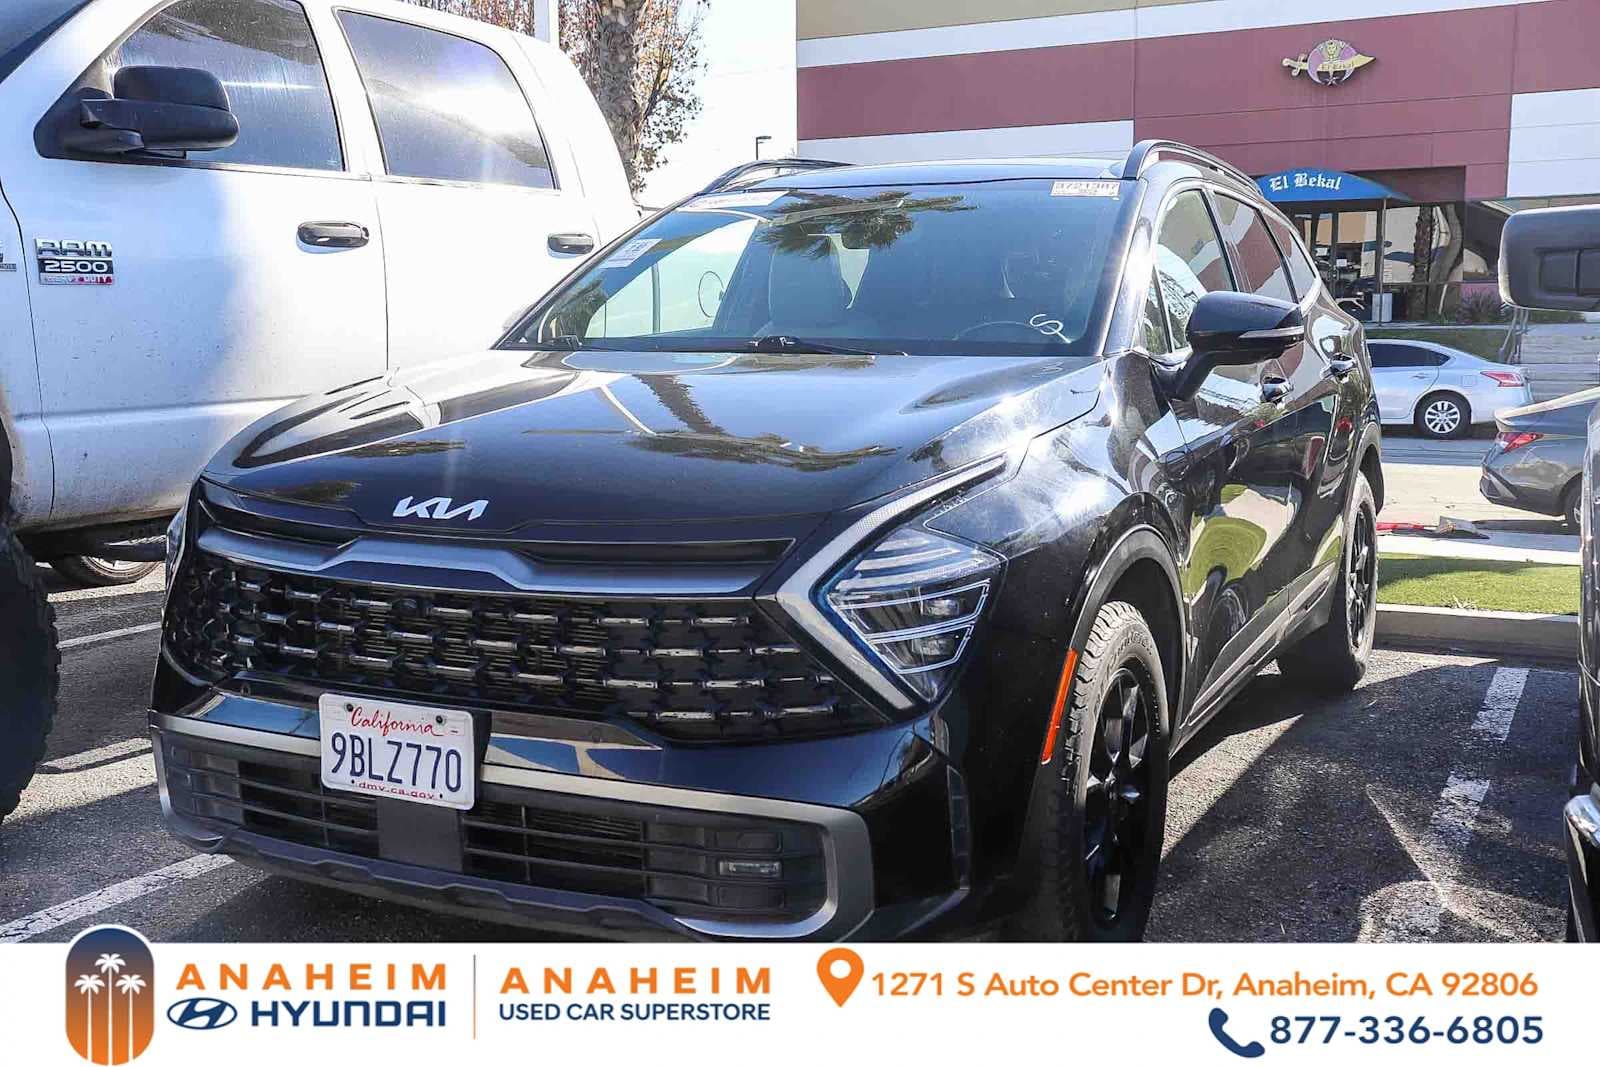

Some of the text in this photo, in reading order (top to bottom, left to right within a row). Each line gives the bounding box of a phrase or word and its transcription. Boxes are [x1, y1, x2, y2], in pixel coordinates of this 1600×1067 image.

[1270, 172, 1342, 192] El Bekal
[35, 238, 113, 257] RAM
[44, 260, 108, 272] 2500
[392, 495, 489, 521] KIA
[351, 706, 444, 737] California
[331, 731, 462, 793] 9BLZ770
